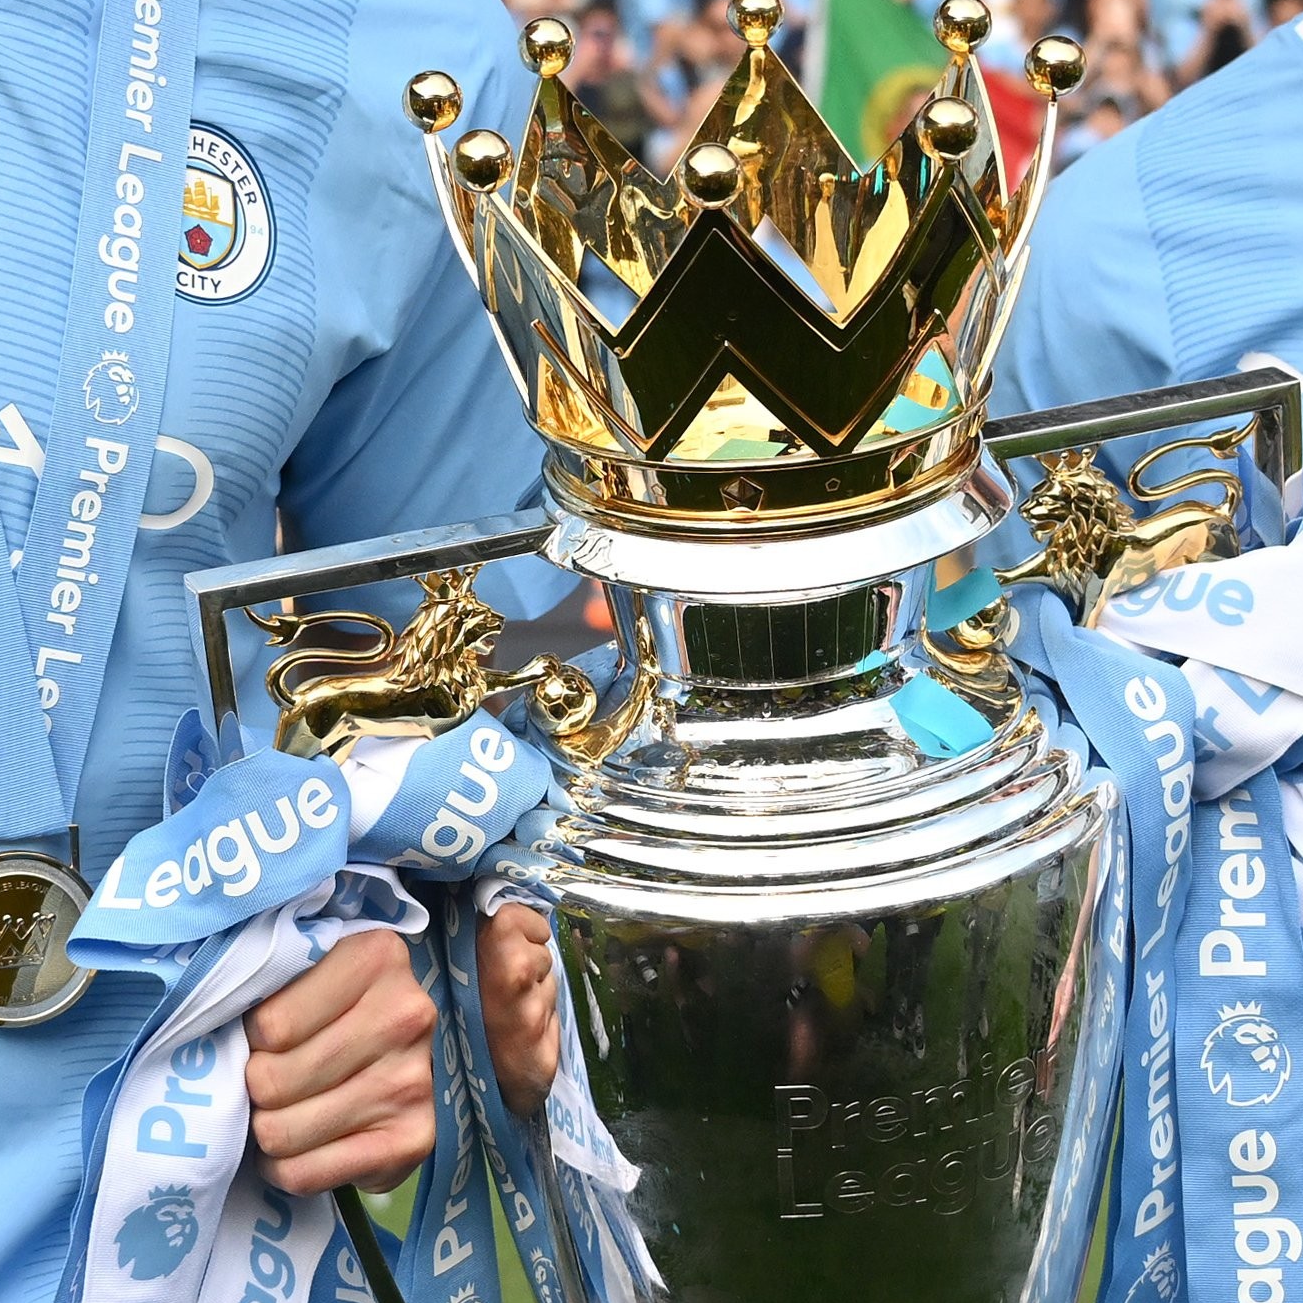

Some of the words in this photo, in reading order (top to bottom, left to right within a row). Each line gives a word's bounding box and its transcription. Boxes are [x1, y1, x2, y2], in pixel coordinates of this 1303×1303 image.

[189, 135, 257, 205] HESTER
[98, 143, 163, 334] League
[176, 271, 222, 294] CITY
[48, 436, 130, 636] Premier
[97, 777, 339, 910] League
[135, 1034, 218, 1159] Pre
[774, 1042, 1058, 1151] Premier
[1134, 970, 1177, 1238] Premier
[776, 1114, 1058, 1218] League
